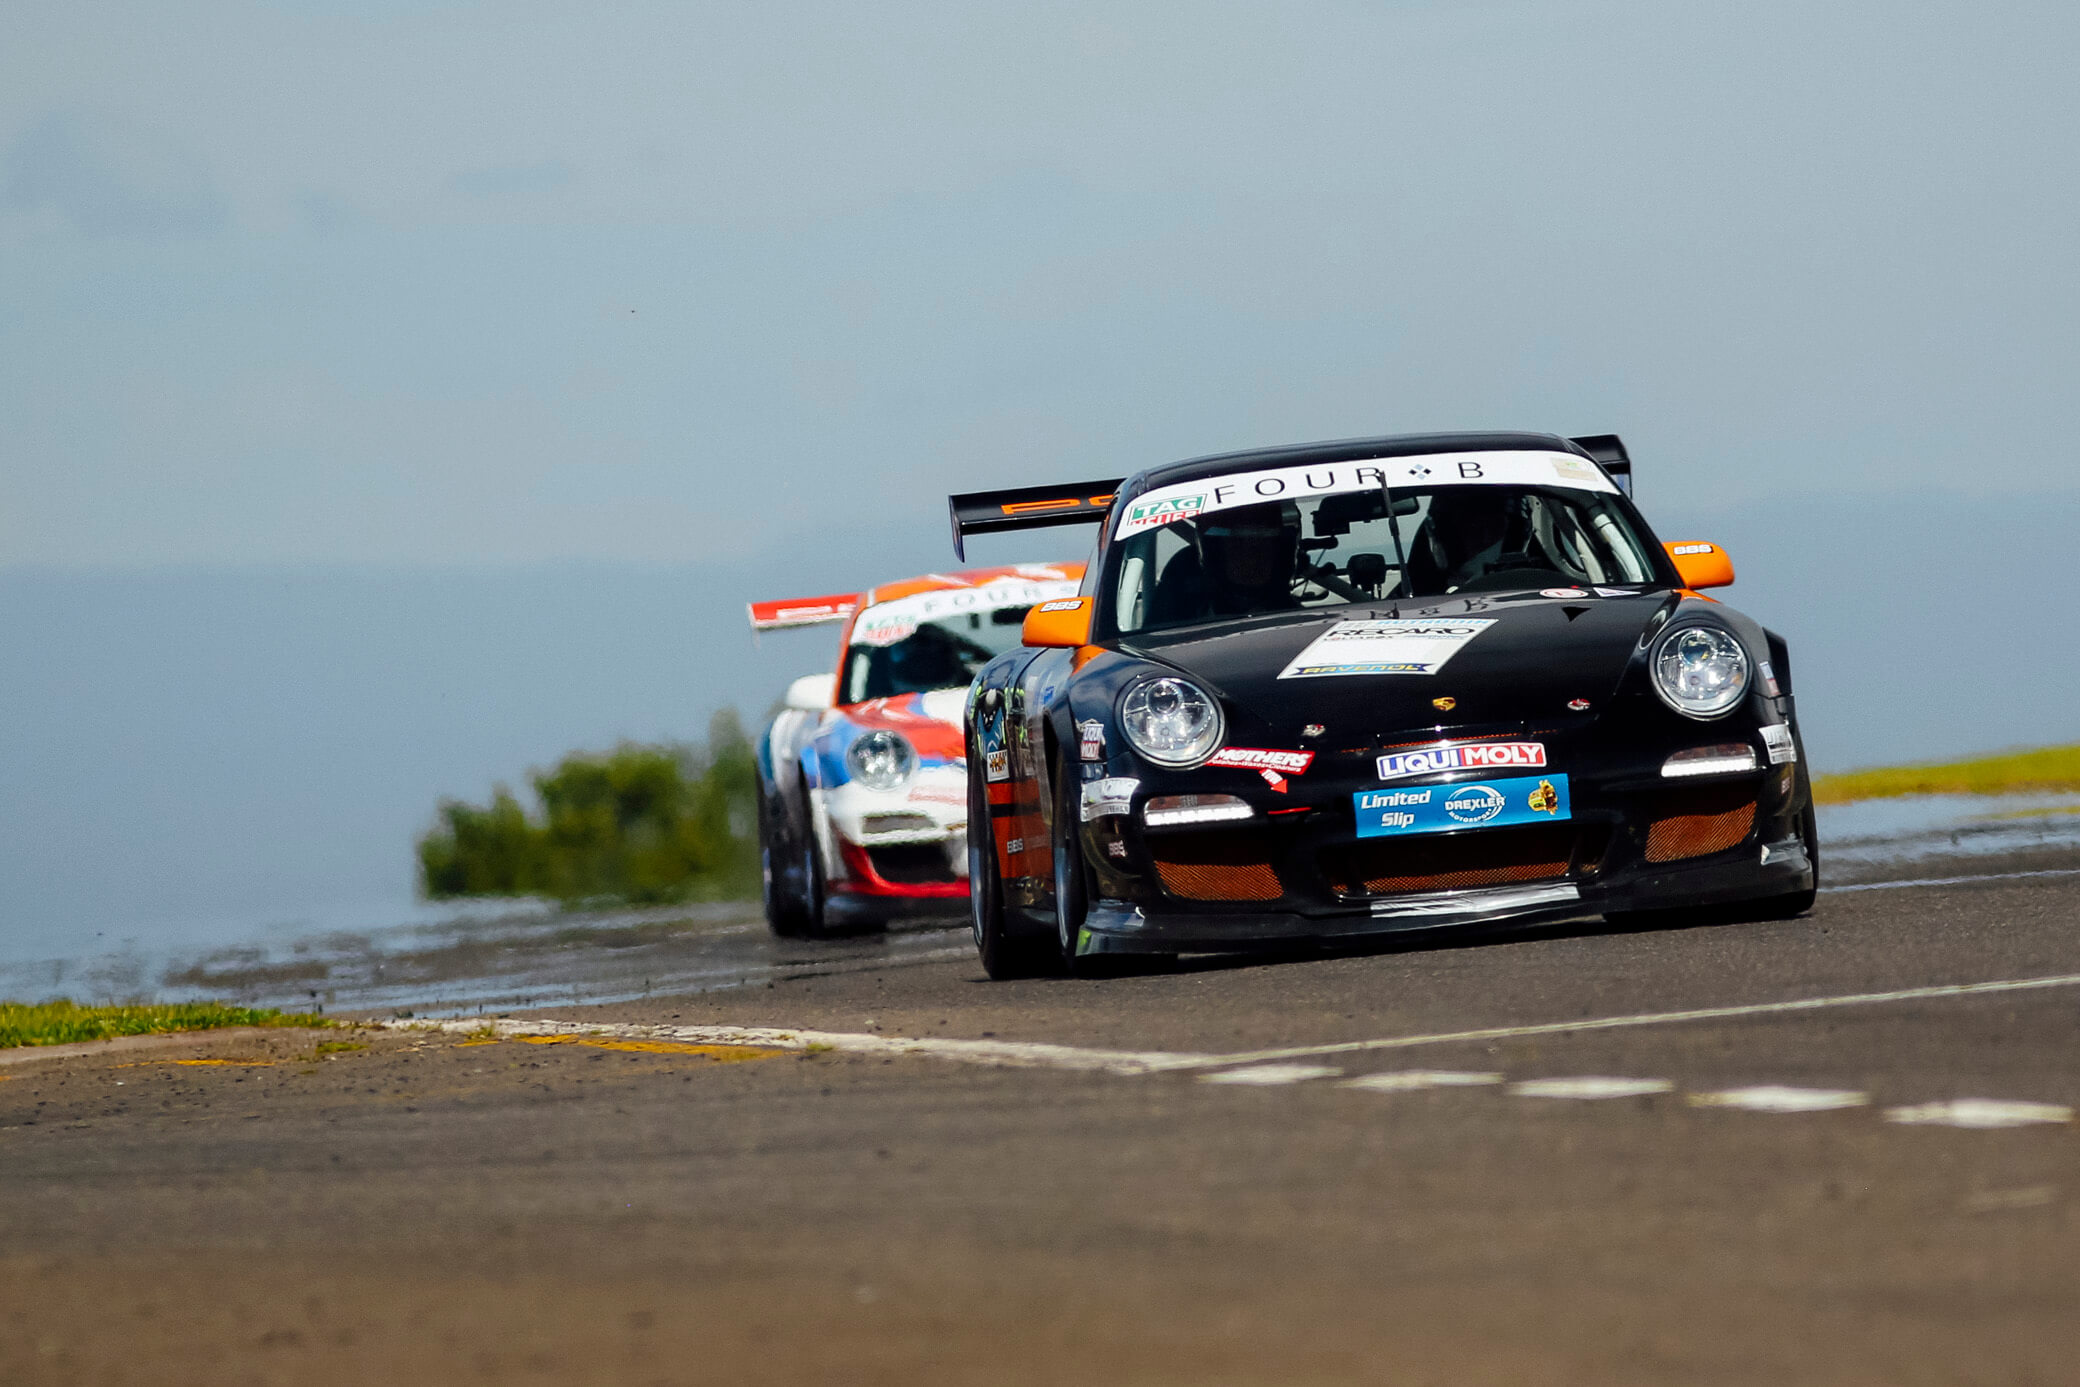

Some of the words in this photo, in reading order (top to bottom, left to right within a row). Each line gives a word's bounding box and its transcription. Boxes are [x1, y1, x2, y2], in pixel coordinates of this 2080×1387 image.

[1214, 467, 1386, 504] FOUR
[1458, 462, 1485, 479] B
[1137, 498, 1200, 517] TAG
[1040, 600, 1083, 612] BBS
[1327, 628, 1476, 637] RECARO
[1213, 748, 1312, 768] MOTHERS
[1382, 749, 1460, 777] LIQUI
[1463, 745, 1541, 766] MOLY
[1360, 789, 1431, 809] Limited
[1445, 797, 1505, 811] DREXLER
[1381, 812, 1415, 828] Slip
[1448, 808, 1493, 822] MOTORSPORT
